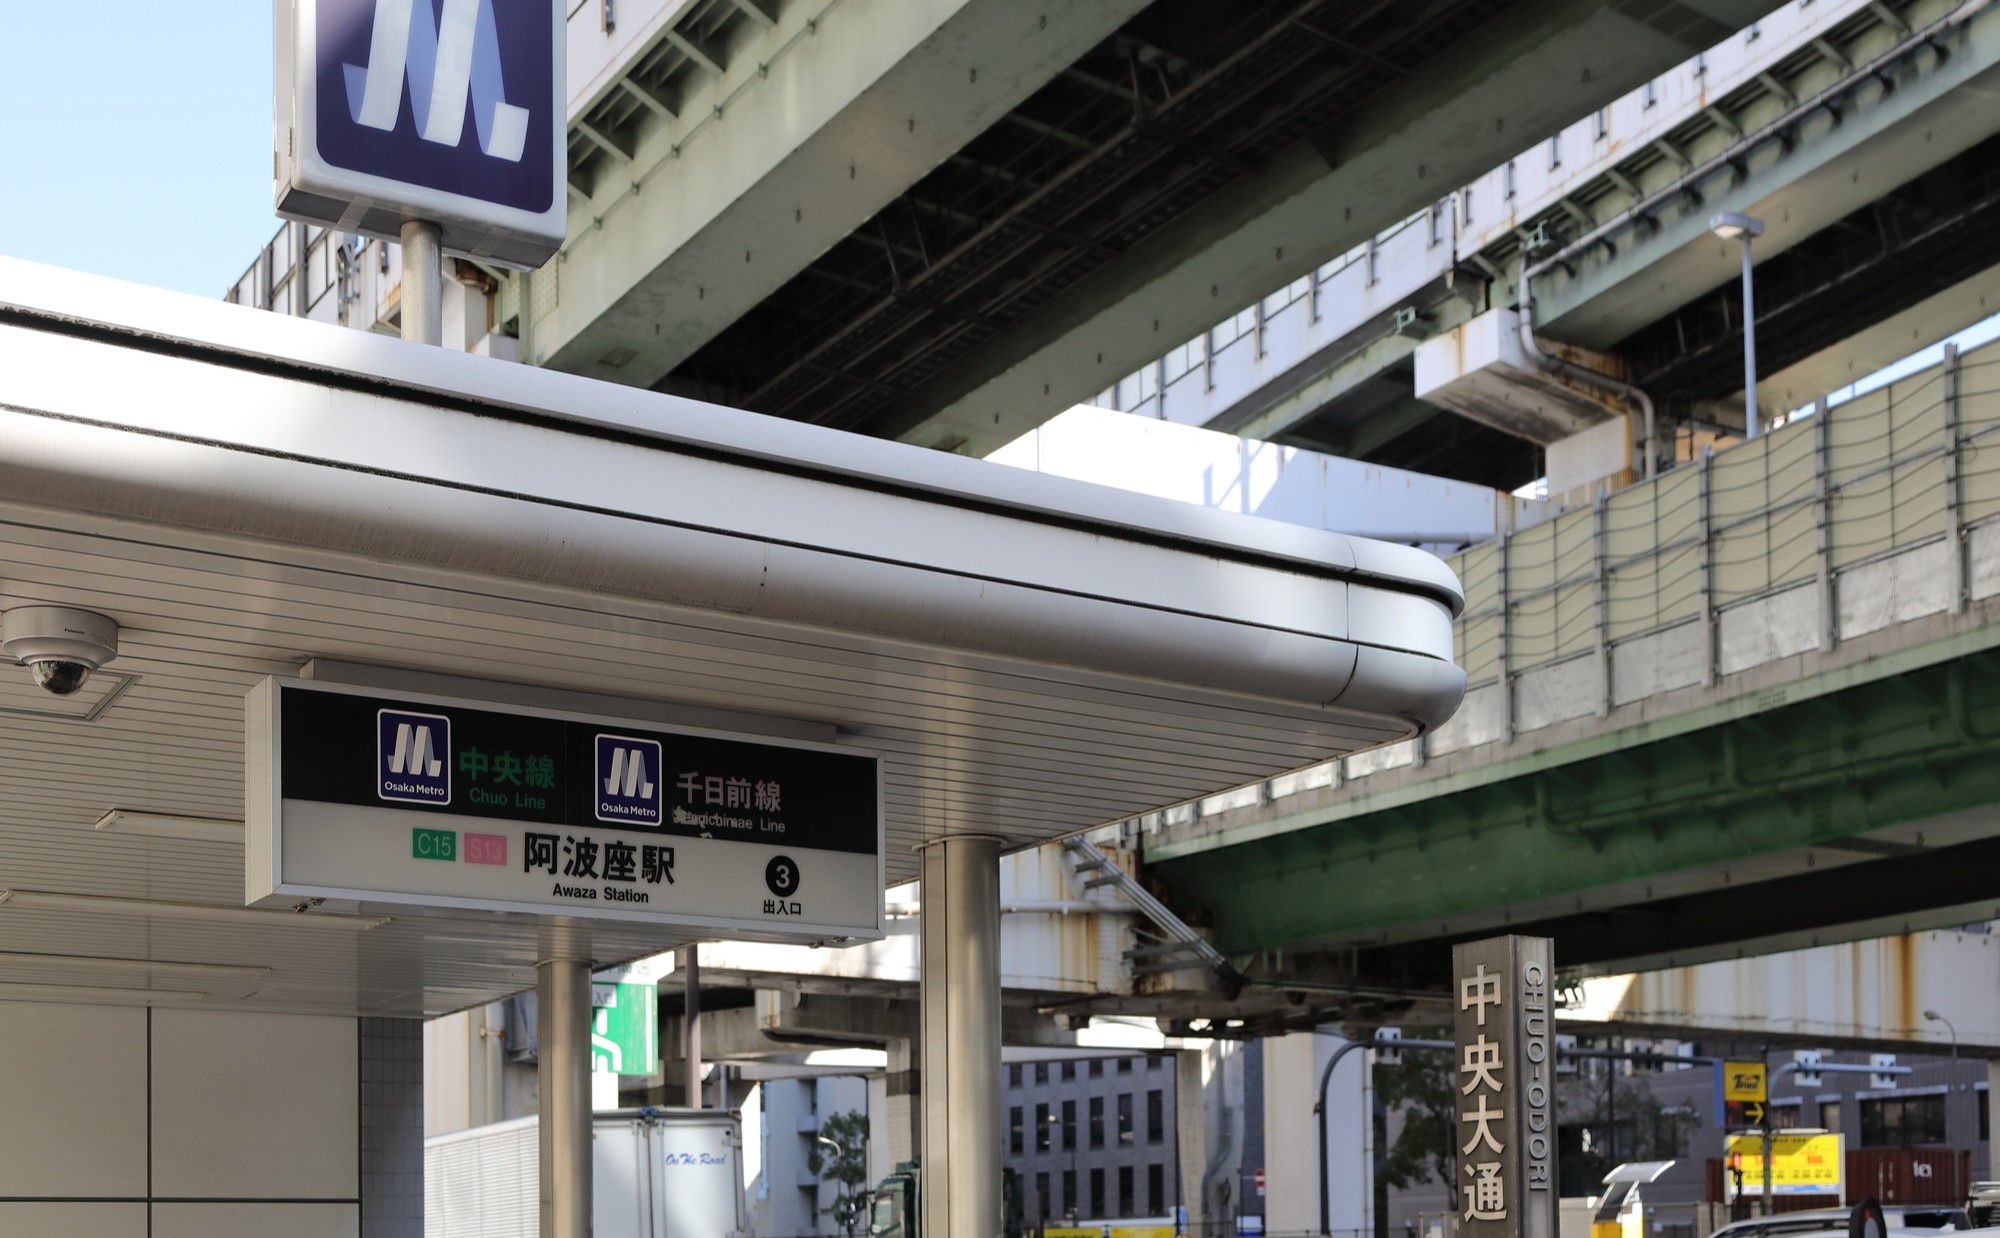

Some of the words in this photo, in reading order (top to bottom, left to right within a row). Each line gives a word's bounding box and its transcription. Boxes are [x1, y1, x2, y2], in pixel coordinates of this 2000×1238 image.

[459, 746, 556, 789] 中央線
[384, 781, 415, 794] Osaka
[416, 785, 445, 796] Metro
[469, 787, 508, 806] Chuo
[515, 792, 547, 810] Line
[676, 771, 782, 813] 千日前線
[601, 802, 629, 814] Osaka
[630, 806, 656, 818] Metro
[760, 818, 786, 833] Line
[417, 833, 451, 857] C15
[470, 839, 502, 861] S13
[524, 832, 675, 885] 阿波座駅
[776, 864, 790, 889] 3
[553, 883, 597, 900] Awaza
[603, 886, 650, 904] Station
[763, 899, 802, 916] 出入口
[1524, 961, 1549, 1192] CHUO-ODORI
[1461, 964, 1508, 1223] 中央大通
[680, 1153, 697, 1165] The
[700, 1153, 728, 1165] Road
